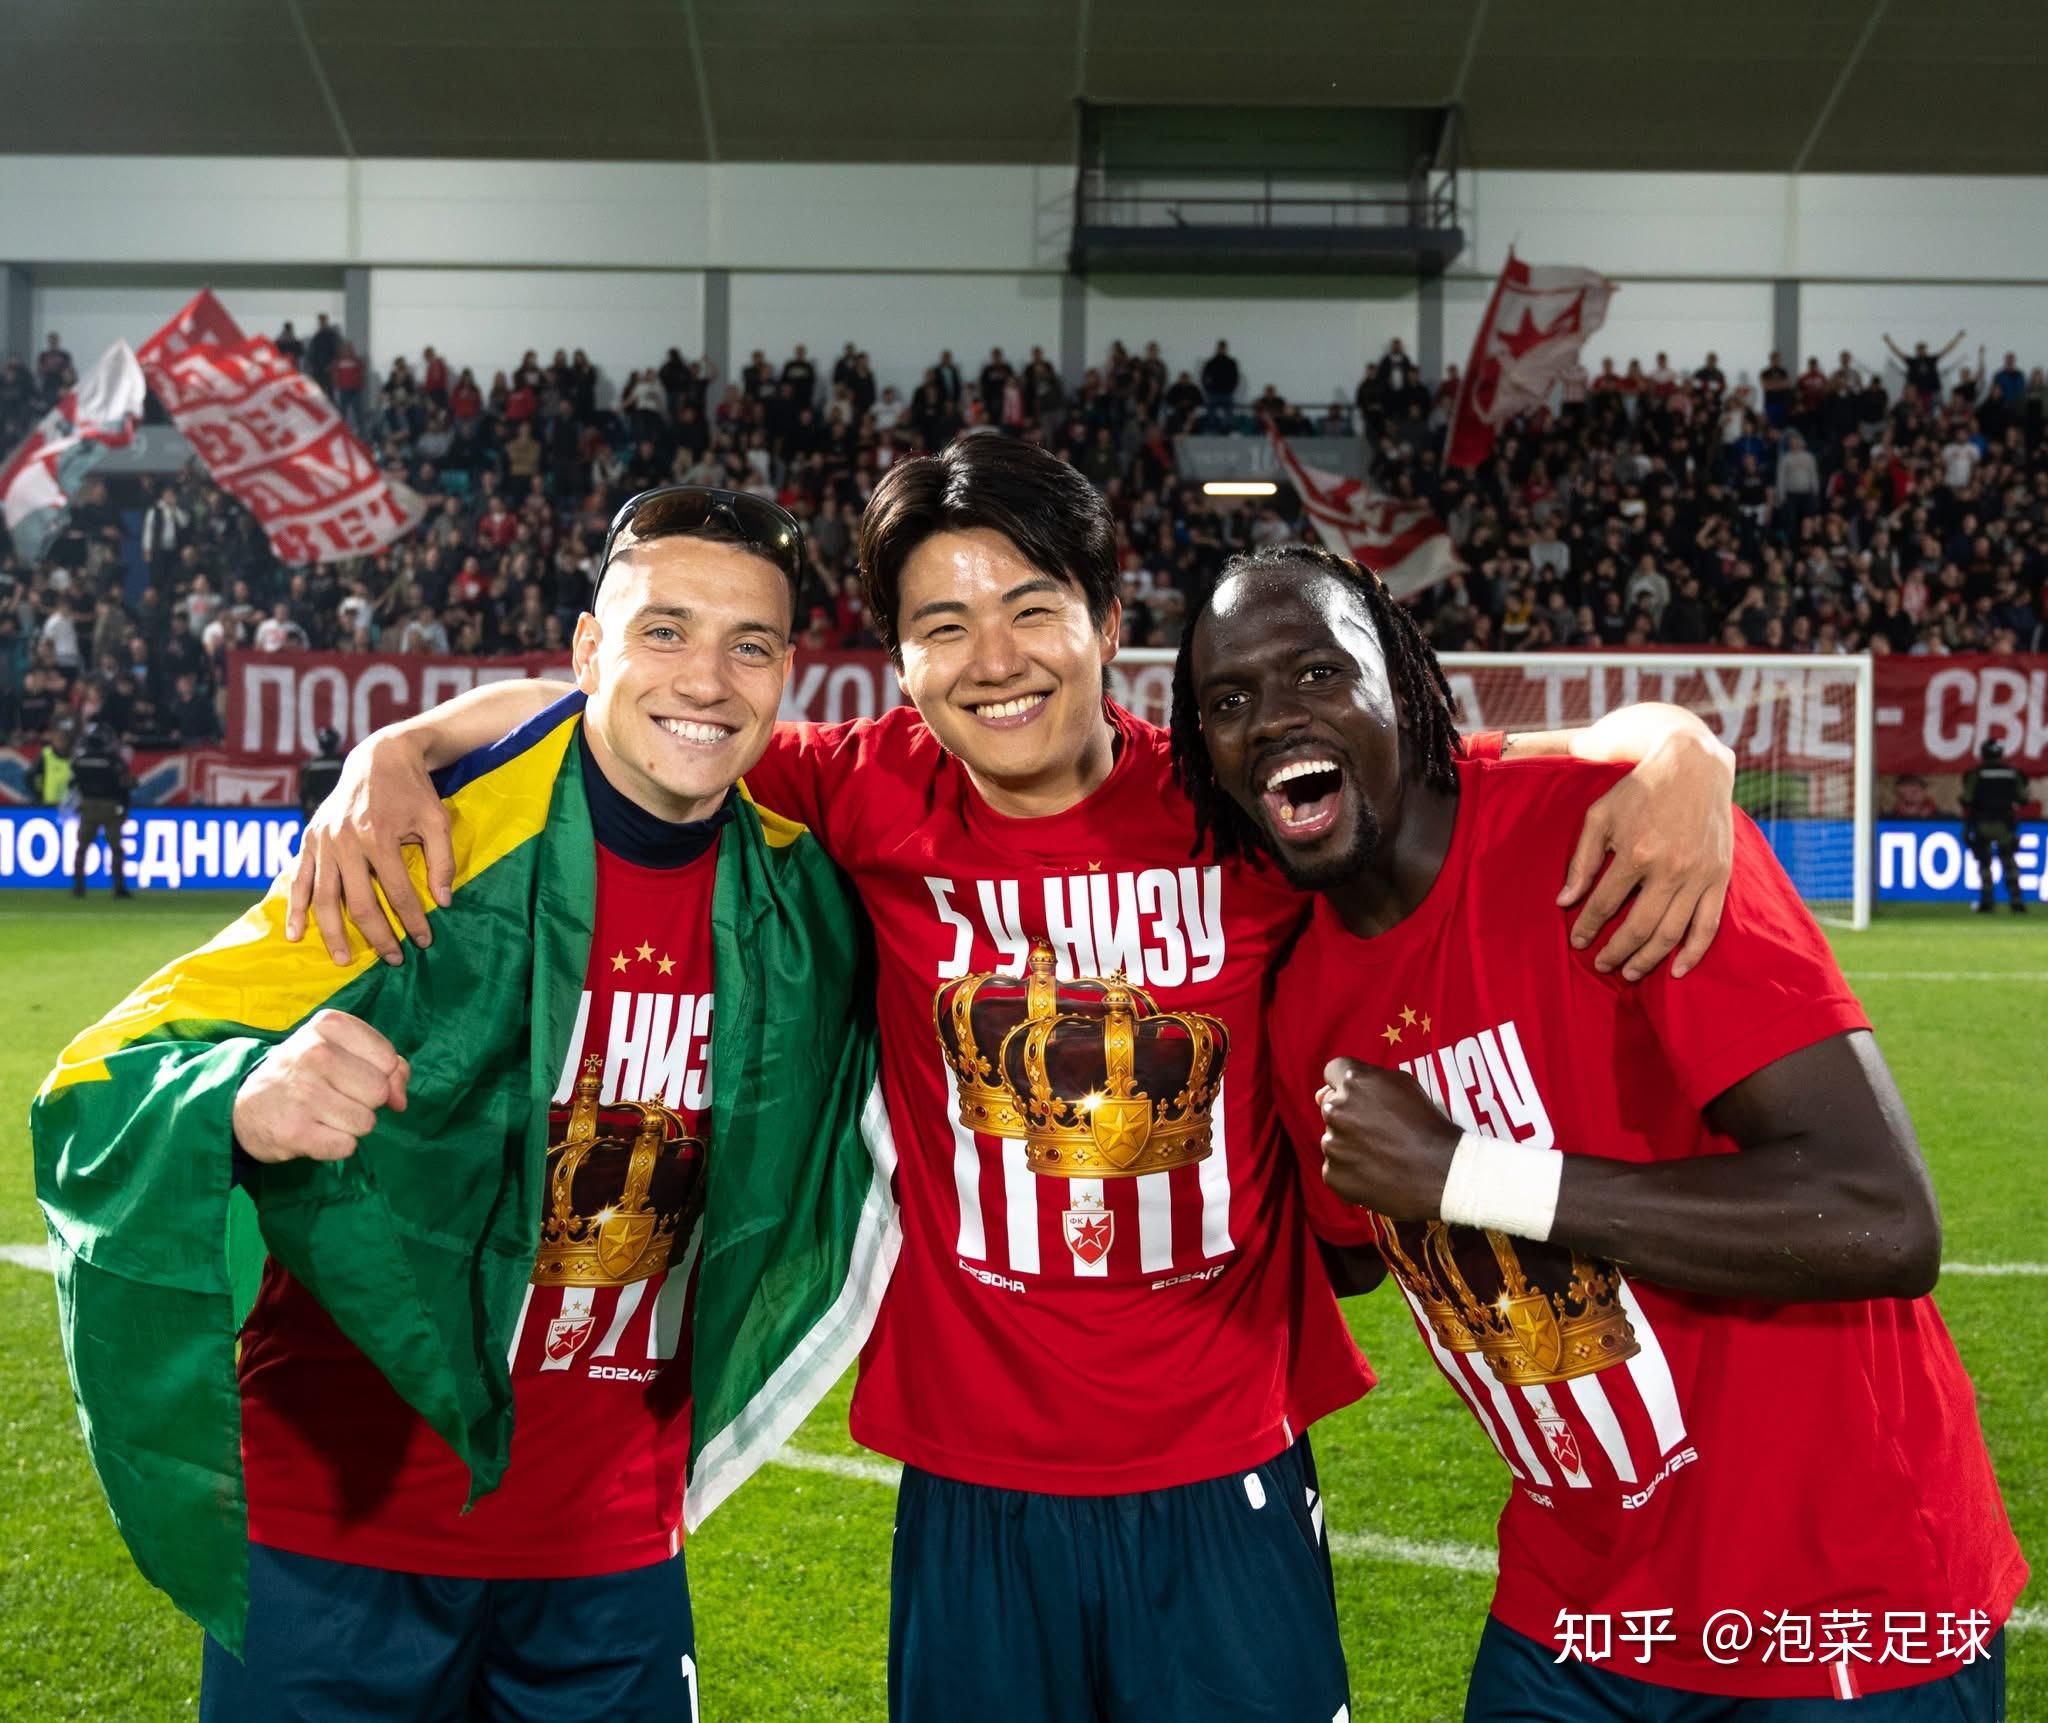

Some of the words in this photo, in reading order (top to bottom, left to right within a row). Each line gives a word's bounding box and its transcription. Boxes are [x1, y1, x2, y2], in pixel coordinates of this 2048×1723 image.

[924, 876, 975, 980] 5
[976, 878, 1030, 981] У
[1043, 865, 1226, 988] НИЗУ
[1398, 1020, 1555, 1149] ИЗУ
[1622, 1447, 1699, 1510] 2024/25
